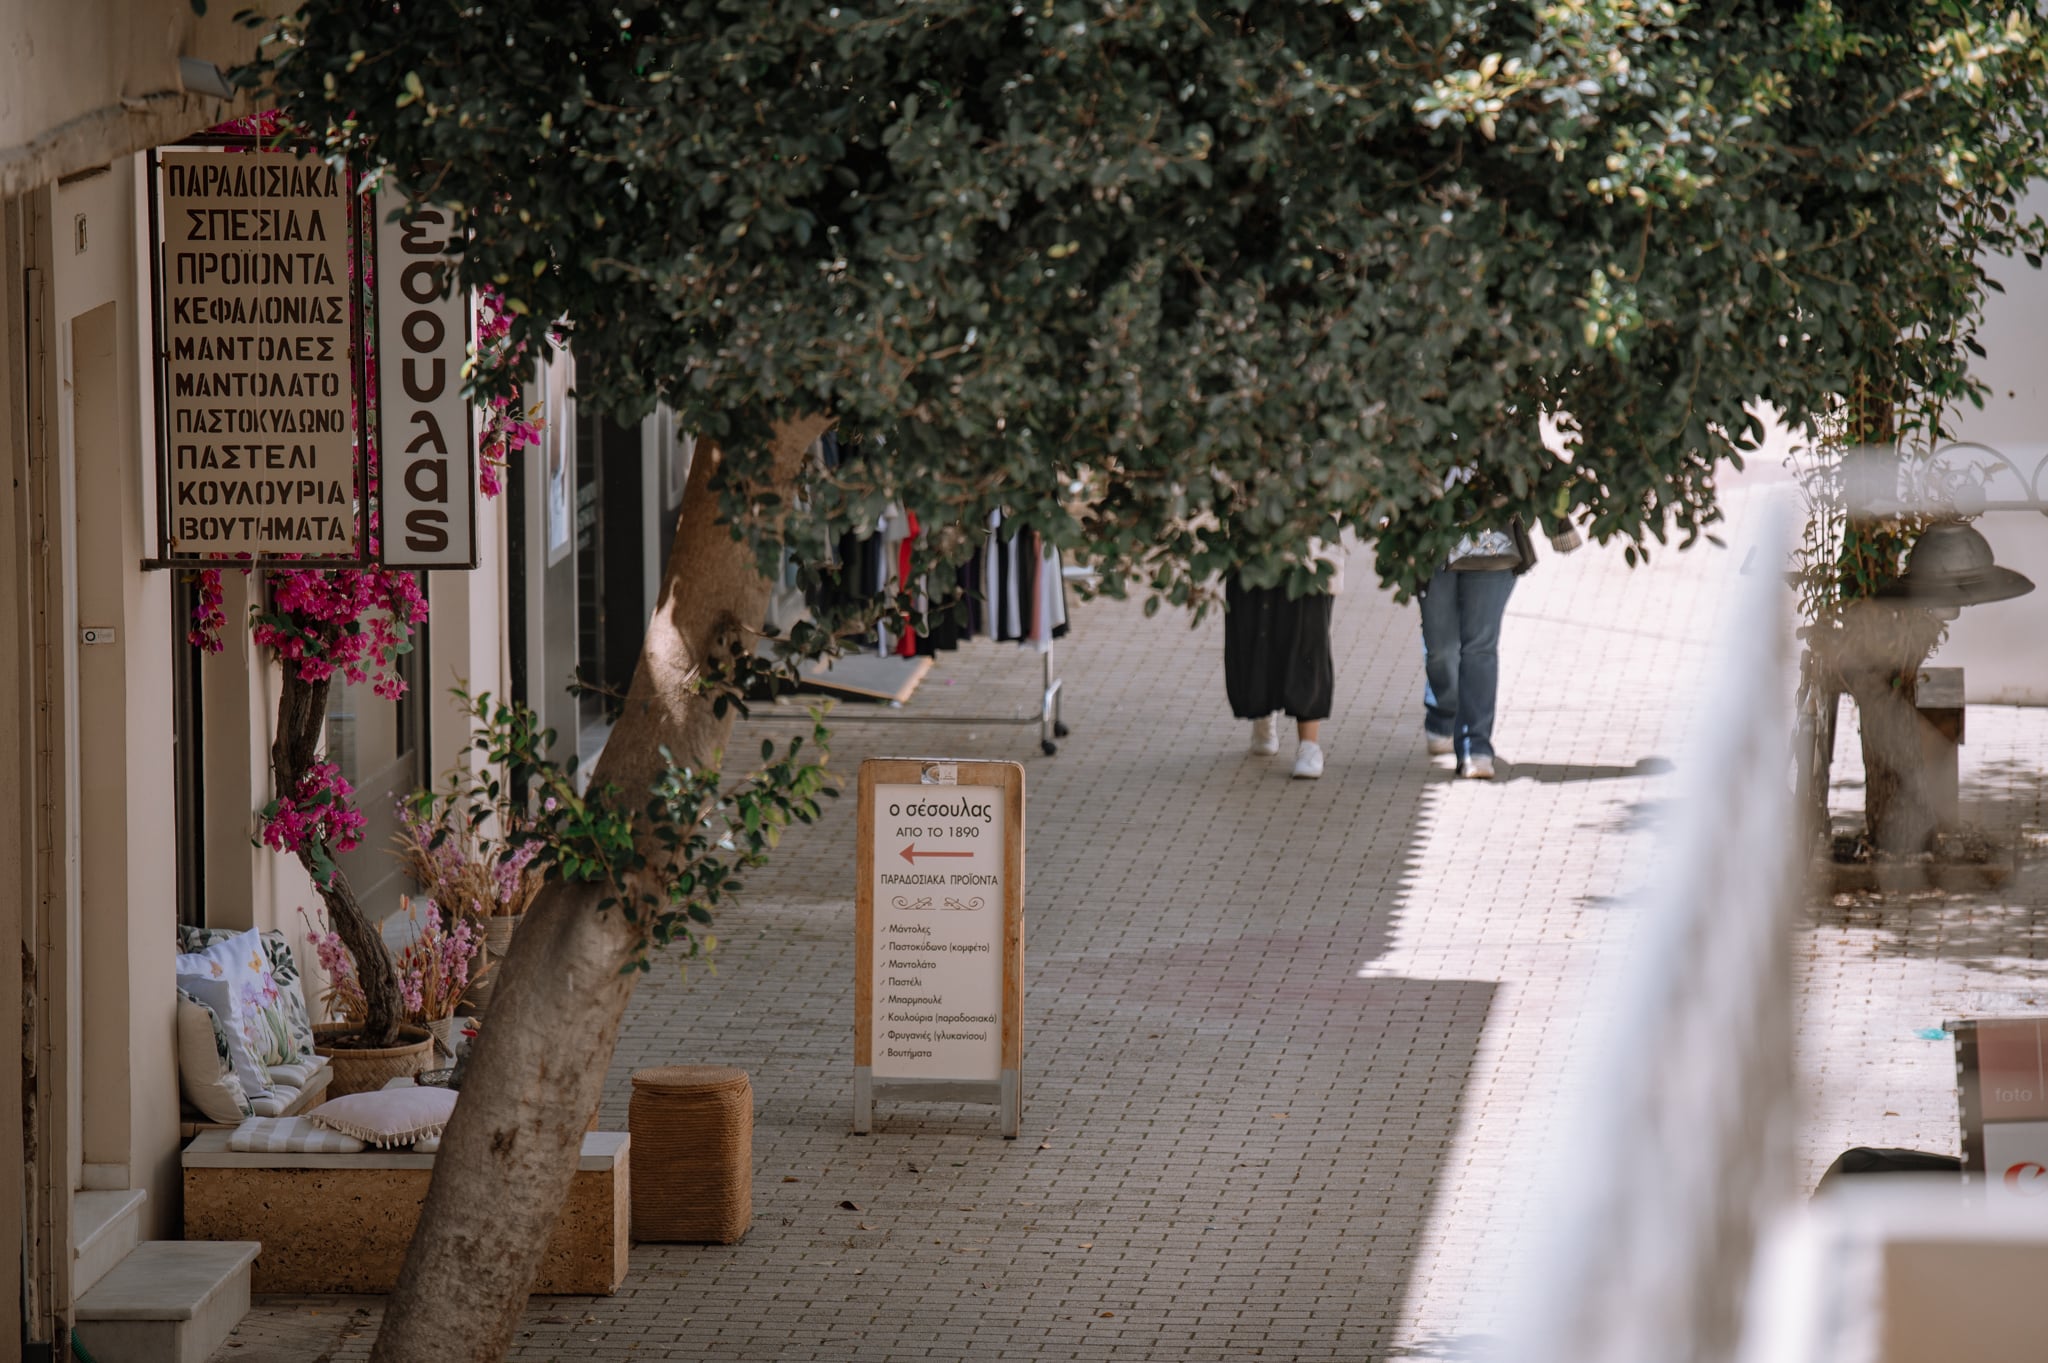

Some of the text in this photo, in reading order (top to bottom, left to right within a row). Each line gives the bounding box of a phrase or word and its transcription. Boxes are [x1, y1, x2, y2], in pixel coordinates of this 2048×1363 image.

[168, 164, 339, 198] ΠΑΡΑΔΟΣΙΑΚΑ
[186, 209, 326, 241] ΣΠΕΣΙΑΛ
[174, 296, 344, 325] ΚΕΦΑΛΟΝΙΑΣ
[174, 336, 335, 361] ΜΑΝΤΟΛΕΣ
[175, 372, 340, 398] ΜΑΝΤΟΛΑΤΟ
[176, 408, 345, 434] ΠΑΣΤΟΚΥΔΩΝΟ
[177, 444, 317, 470] ΠΑΣΤΕΛΙ
[178, 480, 346, 506] ΚΟΥΛΟΥΡΙΑ
[179, 516, 346, 542] ΒΟΥΤΗΜΑΤΑ
[889, 796, 993, 824] ο σέσουλας
[896, 826, 980, 838] ΑΠΟ ΤΟ 1890
[880, 872, 999, 886] ΠΑΡΑΔΟΣΙΑΚΑ ΠΡΟΪΟΝΤΑ
[888, 924, 932, 936] Μάντολες
[888, 941, 990, 954] Παστοκύδωνο (κομφέτο)
[888, 959, 937, 969] Μαντολάτο
[888, 977, 922, 987] Παστέλι
[888, 995, 942, 1007] Μπαρμπουλέ
[888, 1011, 933, 1025] Κουλούρια
[888, 1030, 987, 1042] Φρυγανιές (γλυκανίσου)
[887, 1047, 933, 1060] Βουτήματα
